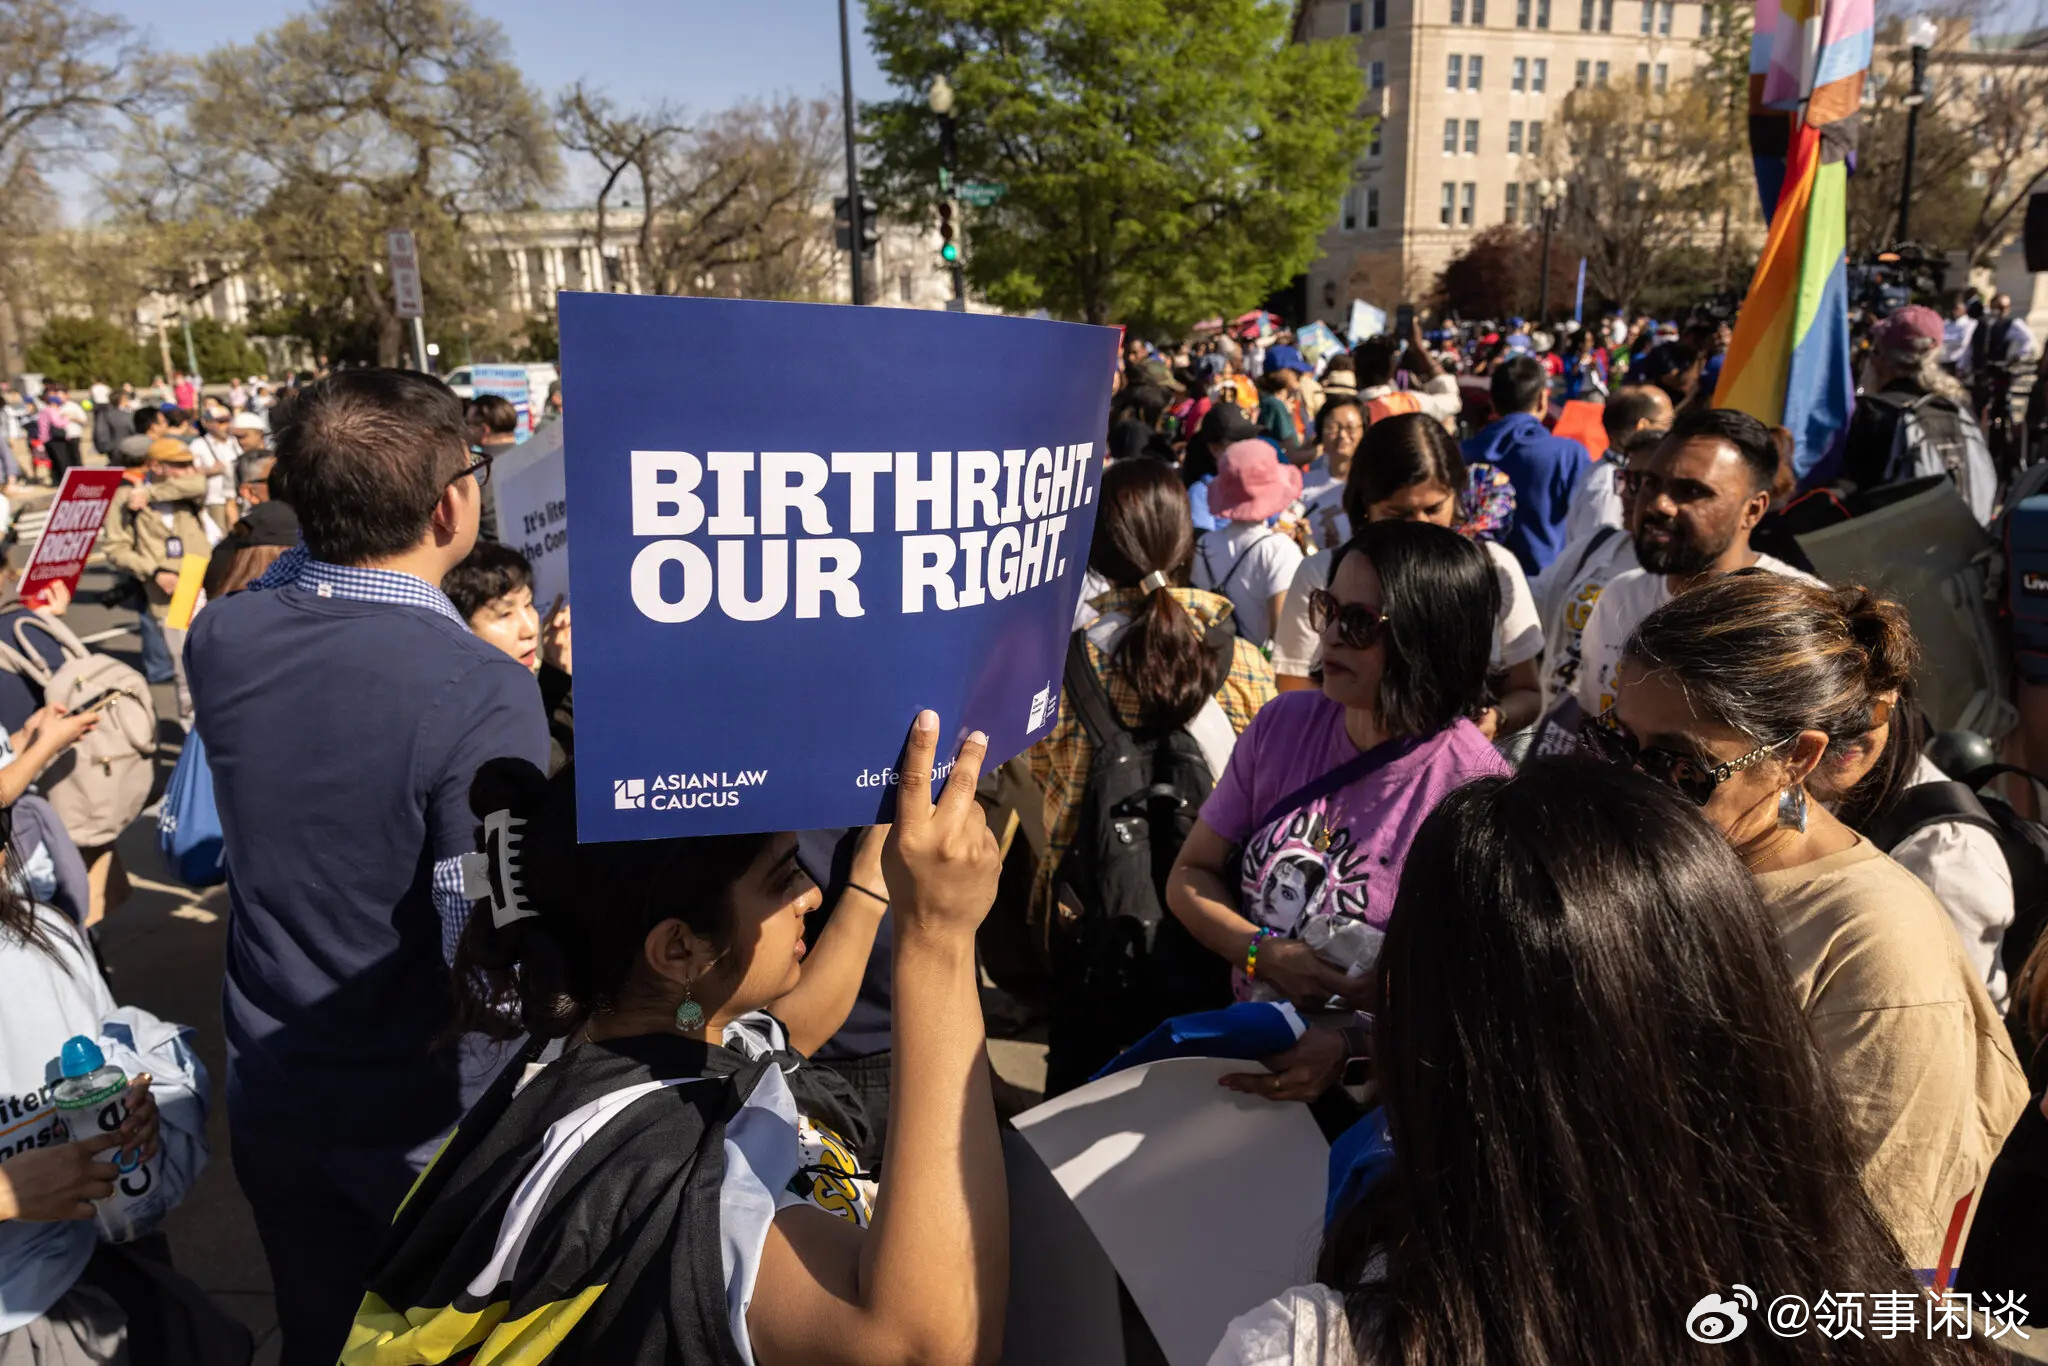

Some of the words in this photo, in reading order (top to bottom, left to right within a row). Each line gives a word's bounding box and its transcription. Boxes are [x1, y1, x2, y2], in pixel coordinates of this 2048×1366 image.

[631, 441, 1094, 536] BIRTHRIGHT.
[50, 498, 109, 531] BIRTH
[523, 510, 546, 535] It's
[35, 530, 97, 563] RIGHT
[631, 537, 865, 623] OUR
[902, 515, 1067, 614] RIGHT.
[651, 772, 718, 792] ASIAN
[722, 769, 769, 788] LAW
[651, 791, 740, 811] CAUCUS
